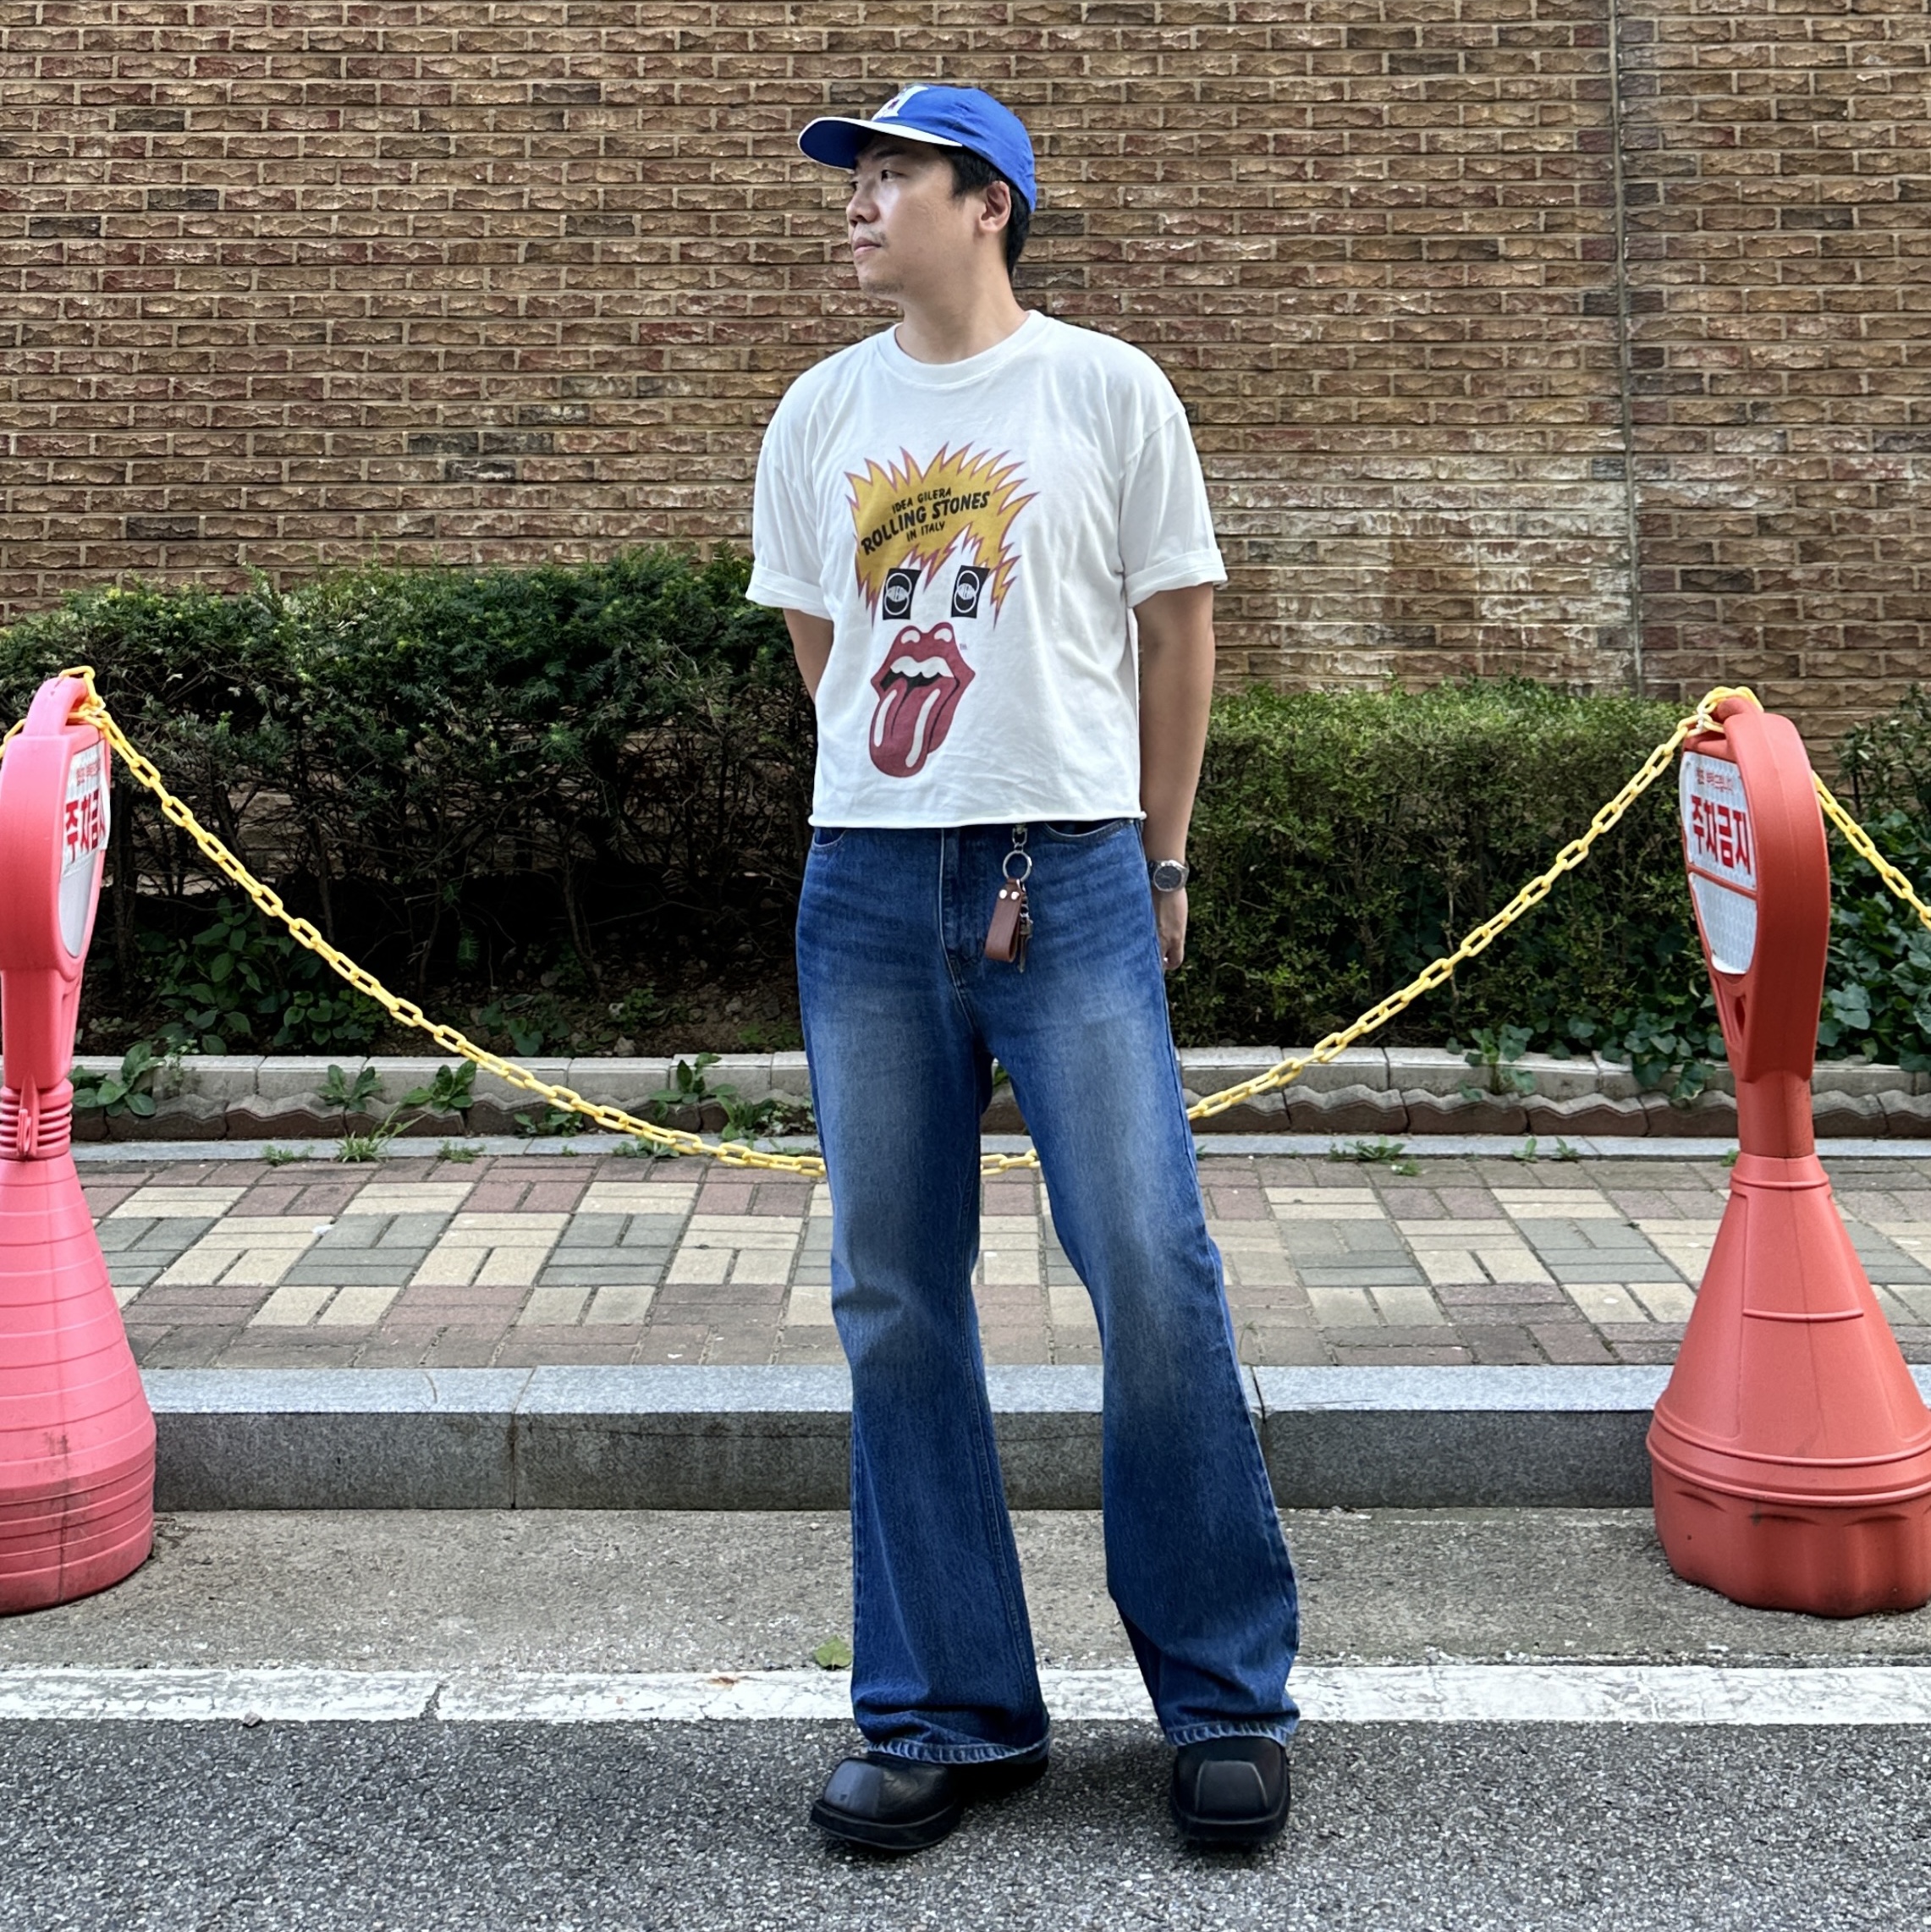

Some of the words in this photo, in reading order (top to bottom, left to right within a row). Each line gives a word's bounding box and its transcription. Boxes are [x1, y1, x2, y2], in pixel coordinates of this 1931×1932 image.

[861, 505, 927, 556] ROLLING
[932, 491, 990, 520] STONES
[892, 497, 913, 515] IDEA
[917, 487, 951, 504] GILERA
[906, 529, 916, 542] IN
[921, 520, 945, 536] ITALY
[1691, 794, 1751, 875] 주차금지
